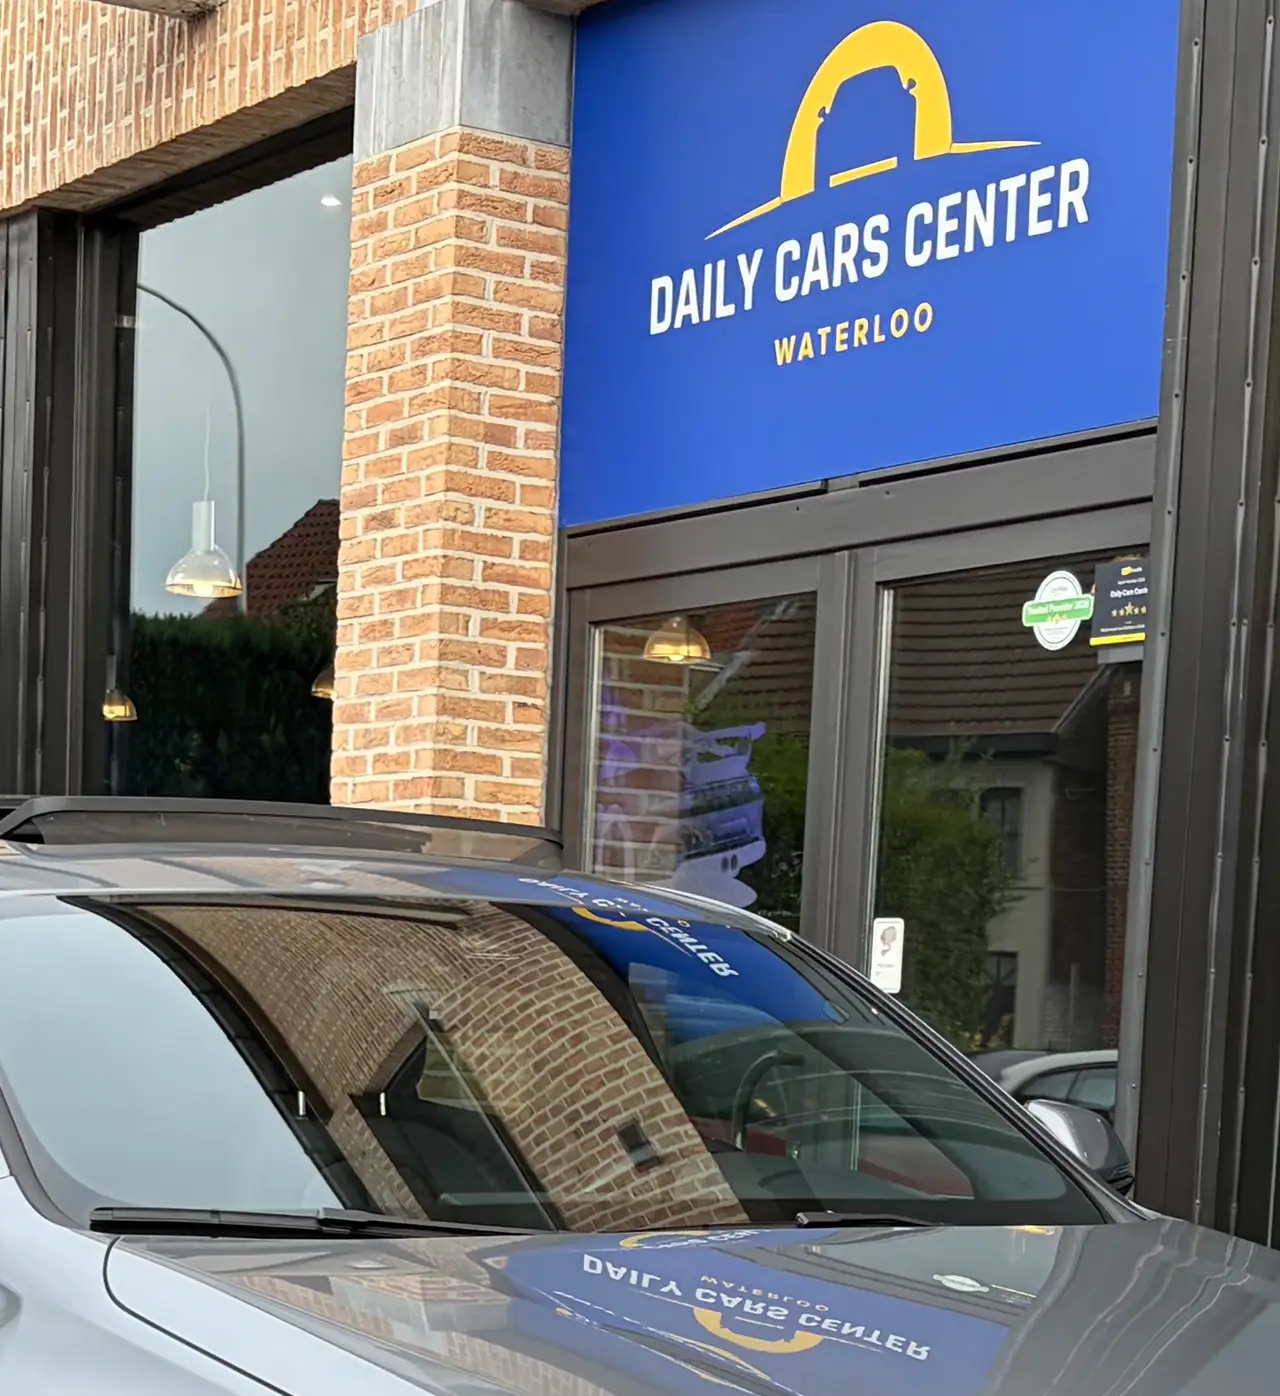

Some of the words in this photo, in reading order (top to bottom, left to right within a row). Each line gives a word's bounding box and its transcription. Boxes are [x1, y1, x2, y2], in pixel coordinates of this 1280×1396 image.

[649, 249, 763, 335] DAILY
[775, 214, 889, 302] CARS
[904, 158, 1090, 267] CENTER
[774, 303, 933, 365] WATERLOO
